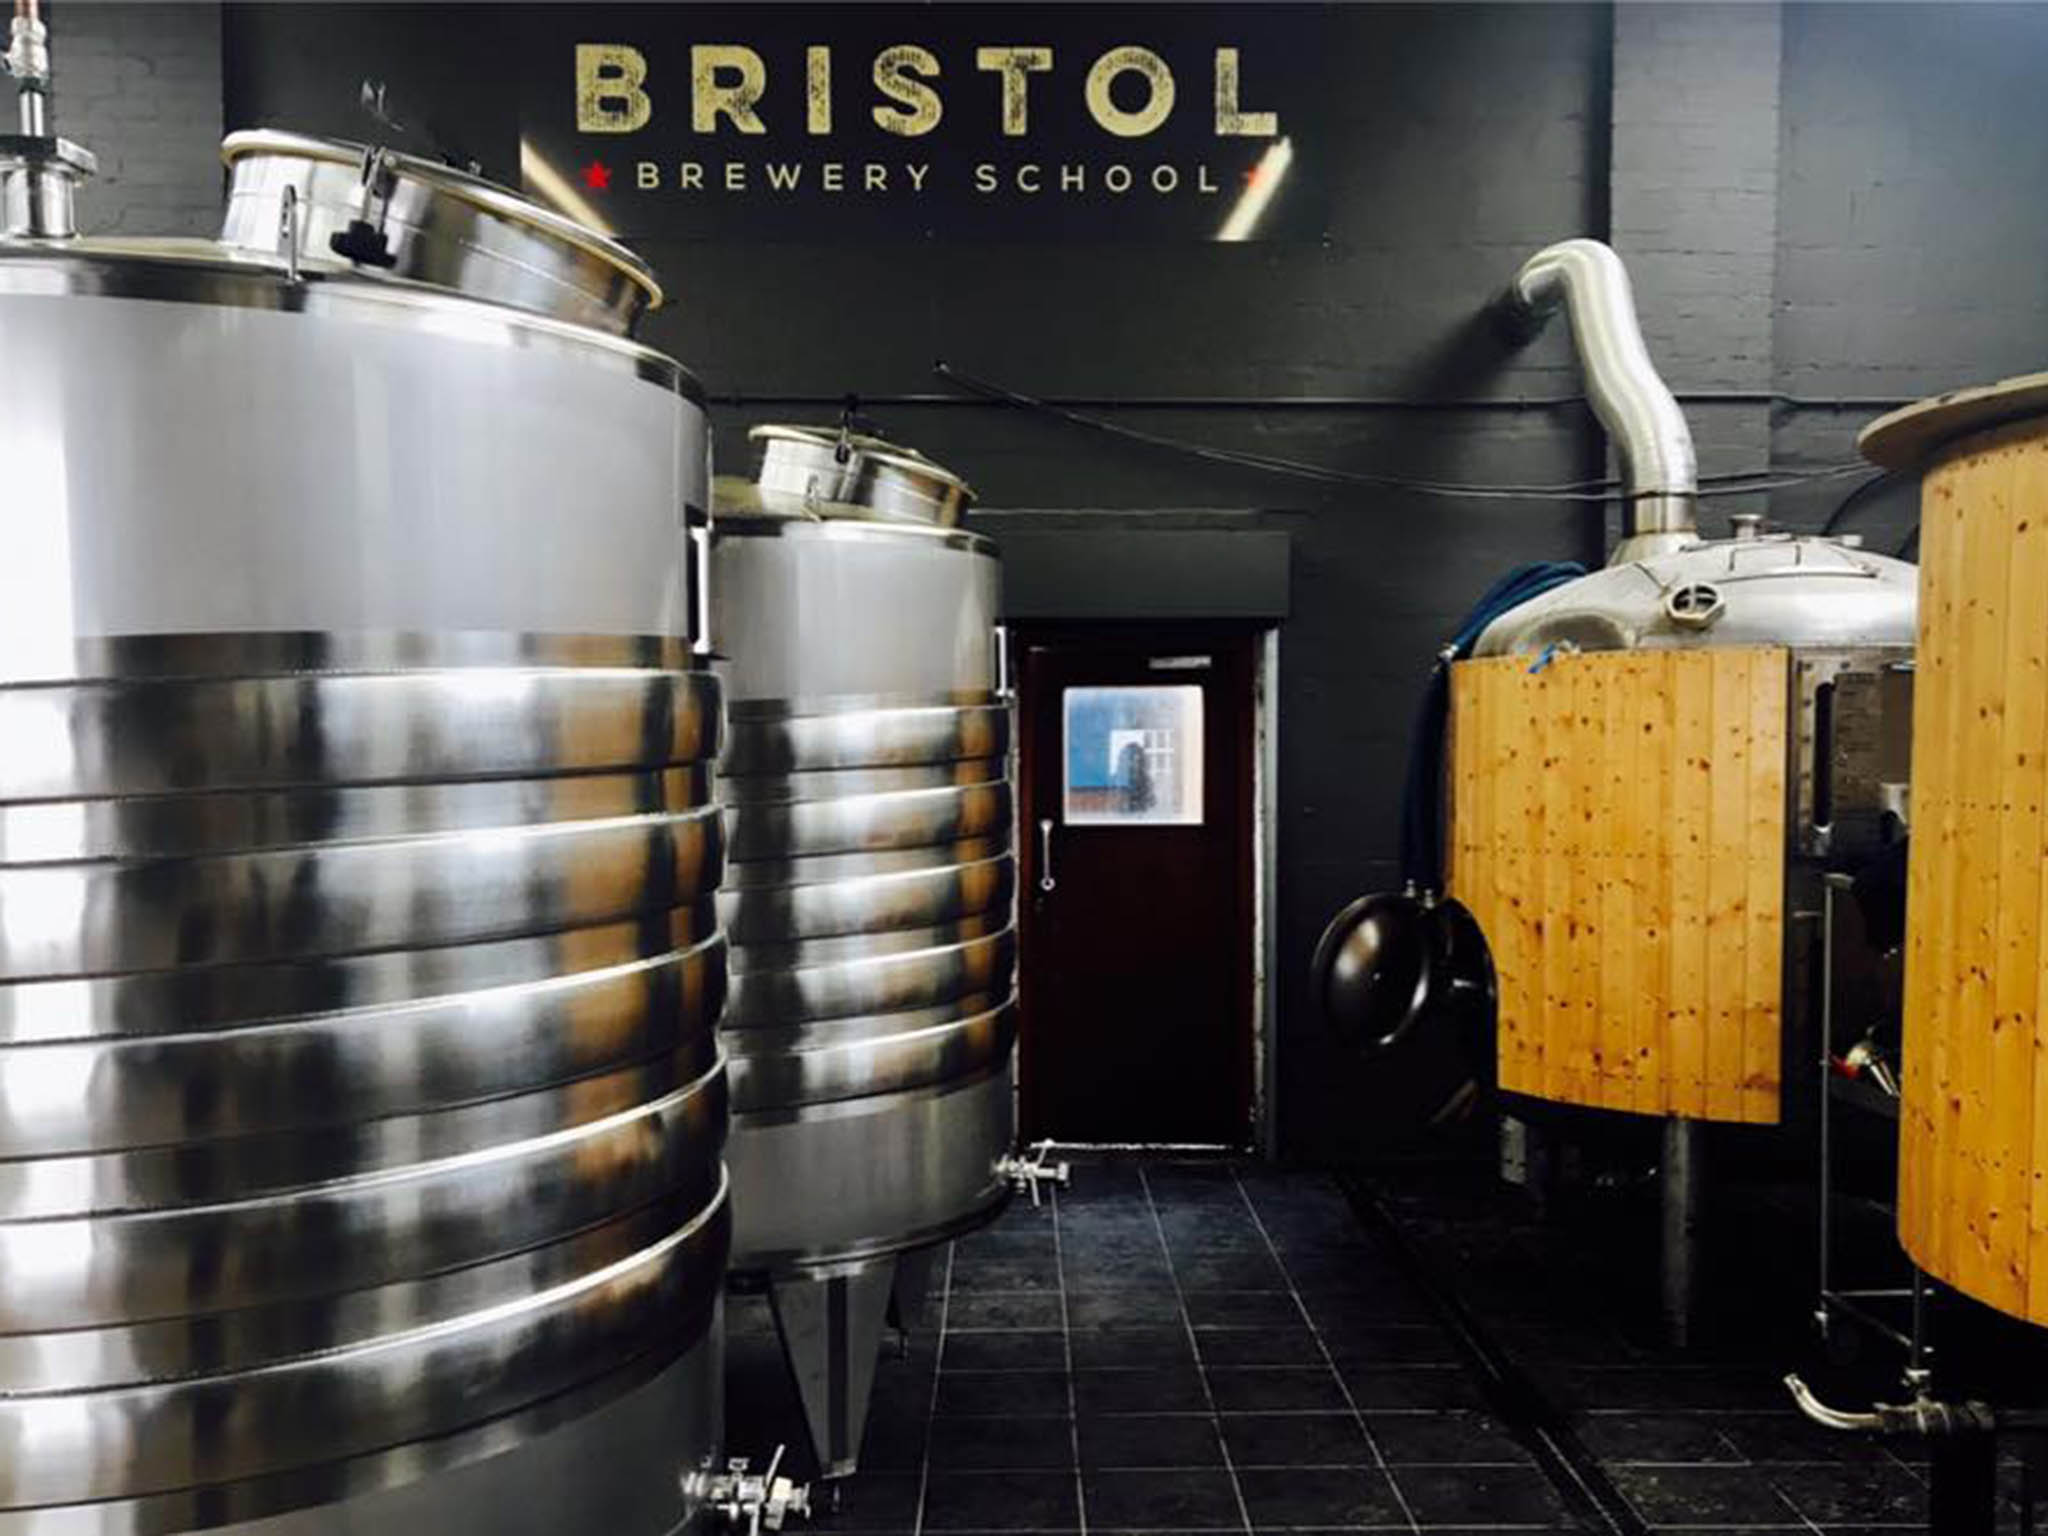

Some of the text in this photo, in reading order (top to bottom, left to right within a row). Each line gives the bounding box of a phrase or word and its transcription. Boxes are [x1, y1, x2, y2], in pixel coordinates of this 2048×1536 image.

[575, 44, 1278, 137] BRISTOL
[636, 162, 1219, 192] BREWERY SCHOOL
